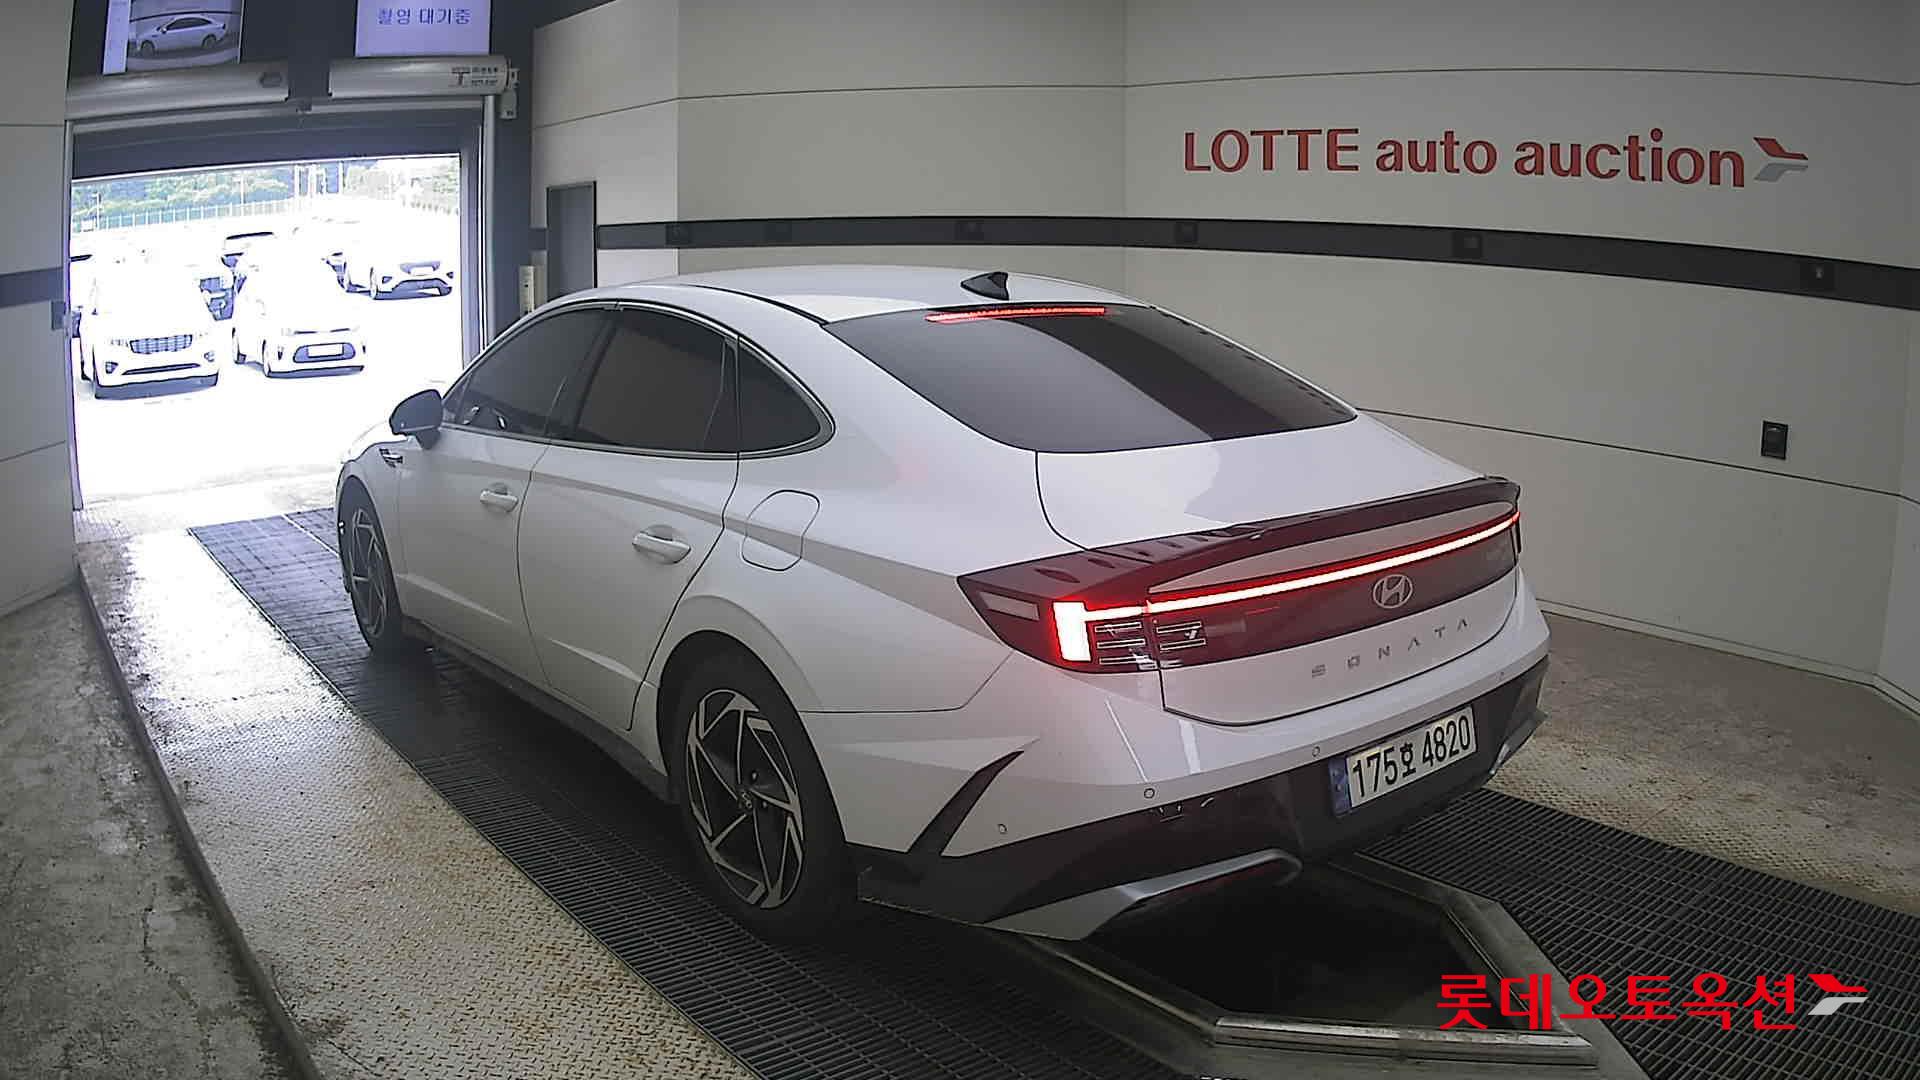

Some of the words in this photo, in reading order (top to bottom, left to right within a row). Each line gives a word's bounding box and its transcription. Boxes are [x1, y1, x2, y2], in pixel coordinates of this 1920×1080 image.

[419, 7, 471, 25] 대기중
[1184, 128, 1360, 172] LOTTE
[1375, 129, 1498, 175] auto
[1513, 127, 1745, 188] auction
[1311, 618, 1469, 678] SONATA
[1352, 742, 1417, 798] 175호
[1422, 714, 1472, 768] 4820
